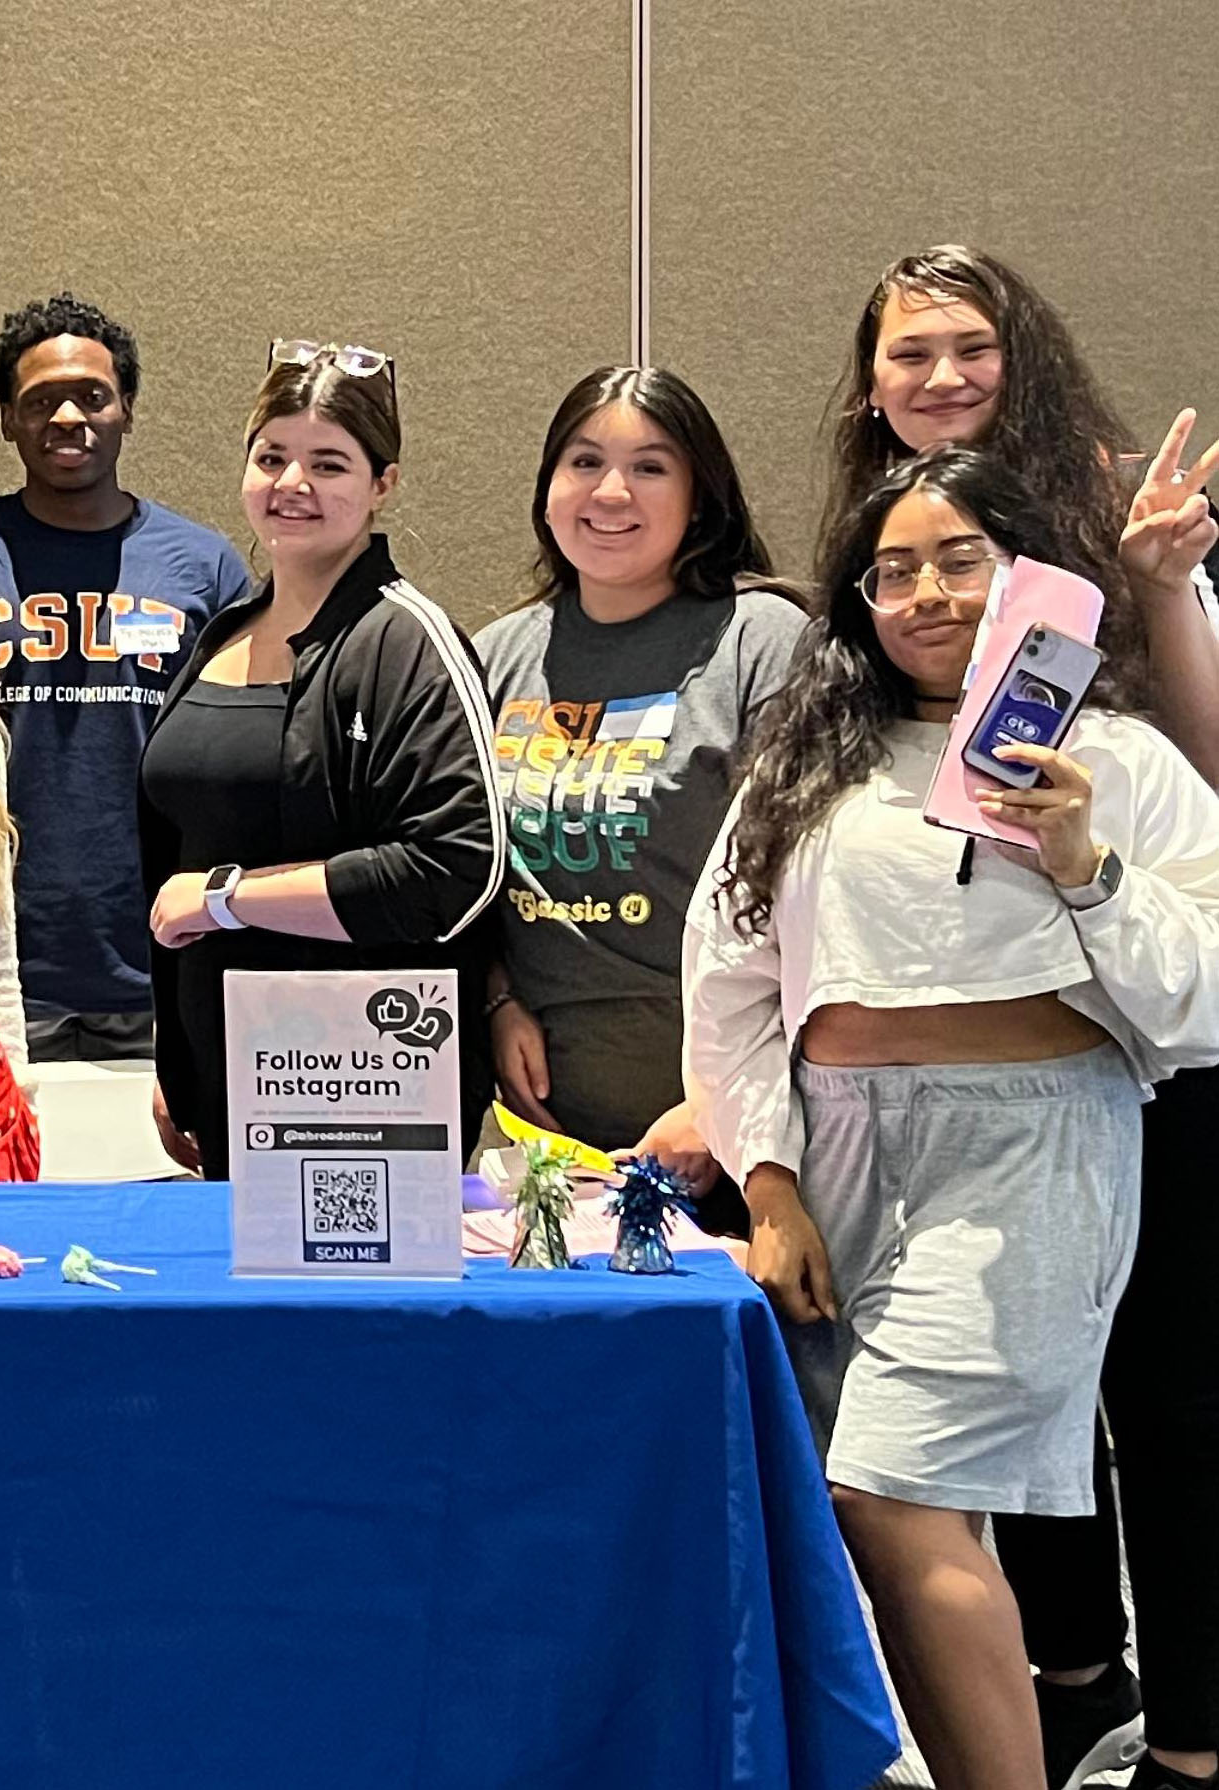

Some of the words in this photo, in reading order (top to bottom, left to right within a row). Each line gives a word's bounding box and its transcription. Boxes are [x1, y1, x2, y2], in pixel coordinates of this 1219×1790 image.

[34, 686, 52, 702] OF
[56, 685, 165, 706] COMMUNICATION
[256, 1050, 342, 1071] Follow
[351, 1051, 383, 1070] Us
[392, 1051, 430, 1070] On
[256, 1076, 401, 1102] Instagram
[315, 1247, 354, 1261] SCAN
[357, 1246, 379, 1260] ME
